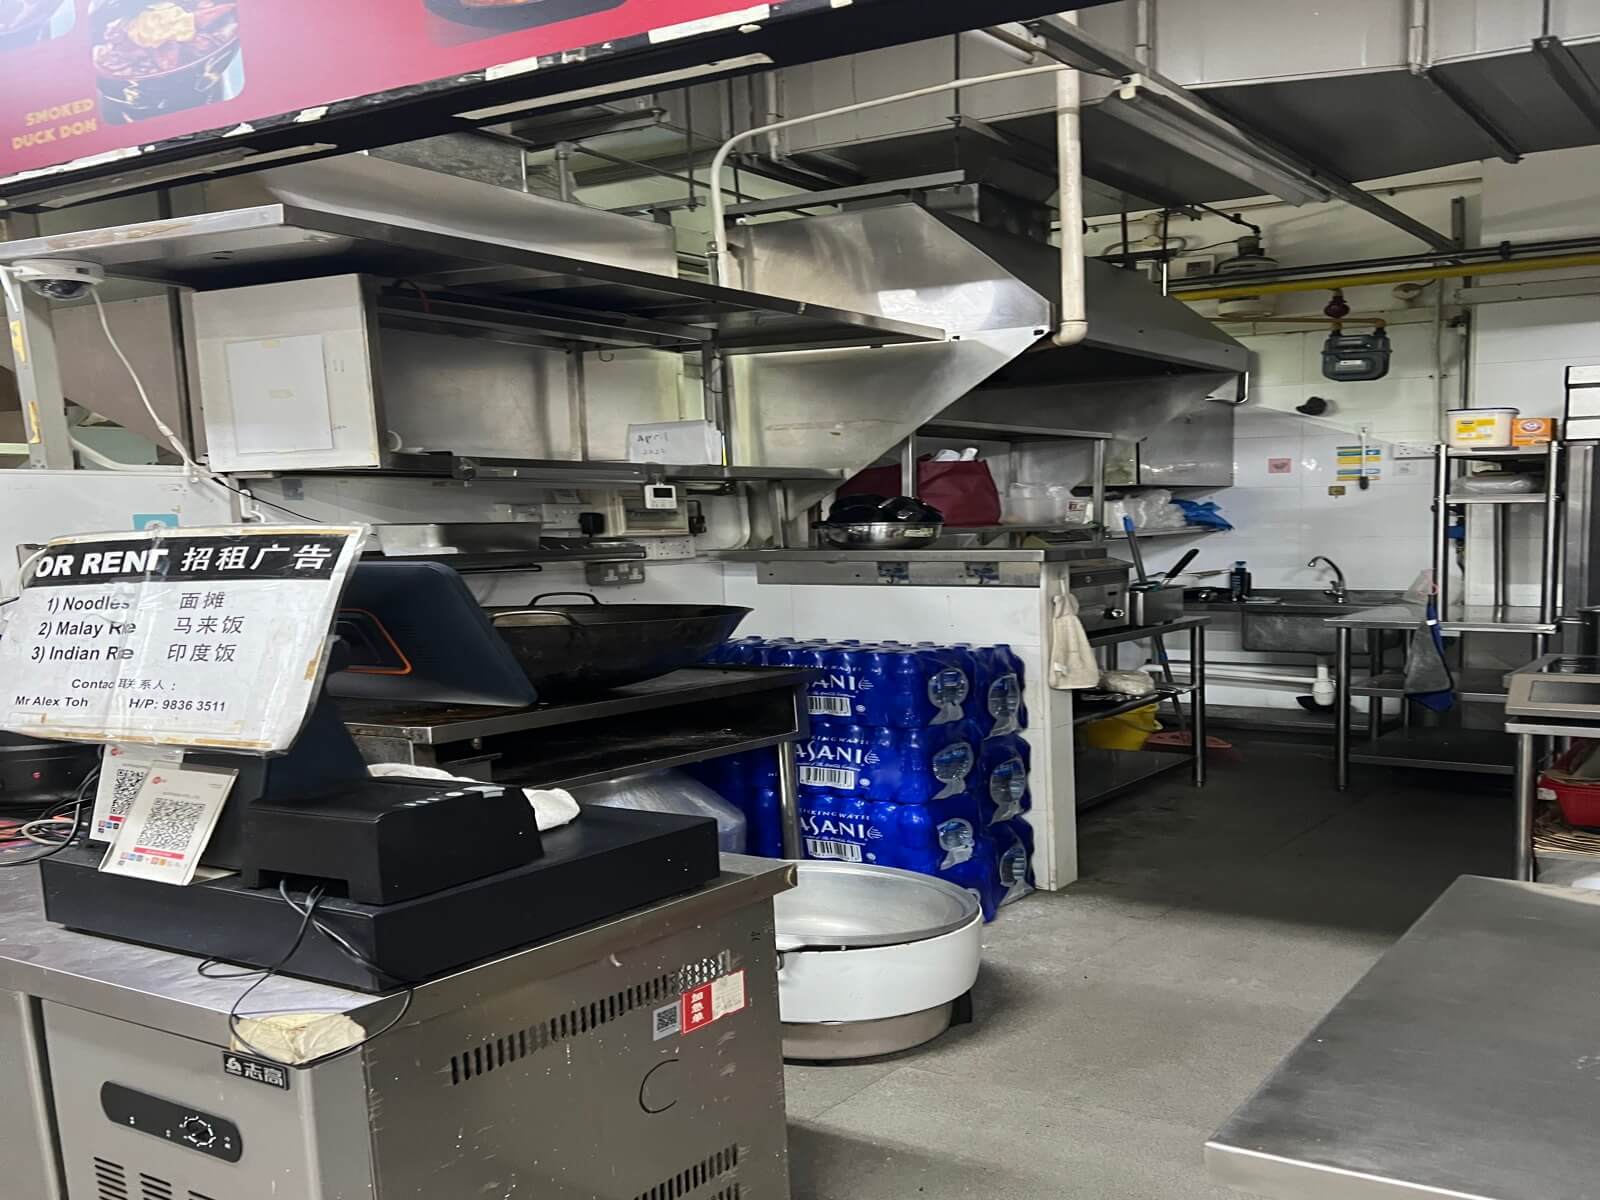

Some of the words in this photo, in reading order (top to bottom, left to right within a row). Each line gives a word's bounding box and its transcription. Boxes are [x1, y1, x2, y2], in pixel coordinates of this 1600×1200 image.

[24, 99, 94, 127] SMOKED
[11, 128, 56, 150] DUCK
[60, 117, 96, 138] DON
[35, 554, 75, 578] OR
[80, 549, 169, 575] RENT
[180, 544, 332, 571] 招租广告
[47, 598, 60, 614] 1)
[62, 596, 130, 611] Noodles
[179, 592, 226, 610] 面摊
[38, 622, 53, 639] 2)
[55, 621, 104, 638] Malay
[173, 616, 245, 635] 马来饭
[31, 646, 46, 663] 3)
[49, 646, 100, 660] Indian
[167, 643, 237, 662] 印度饭
[71, 678, 115, 689] Contac
[15, 696, 30, 705] Mr
[32, 696, 60, 706] Alex
[64, 697, 89, 707] Toh
[128, 698, 159, 709] H/P:
[162, 699, 193, 710] 9836
[196, 701, 226, 712] 3511
[796, 741, 863, 764] ASANI
[639, 1059, 679, 1114] C
